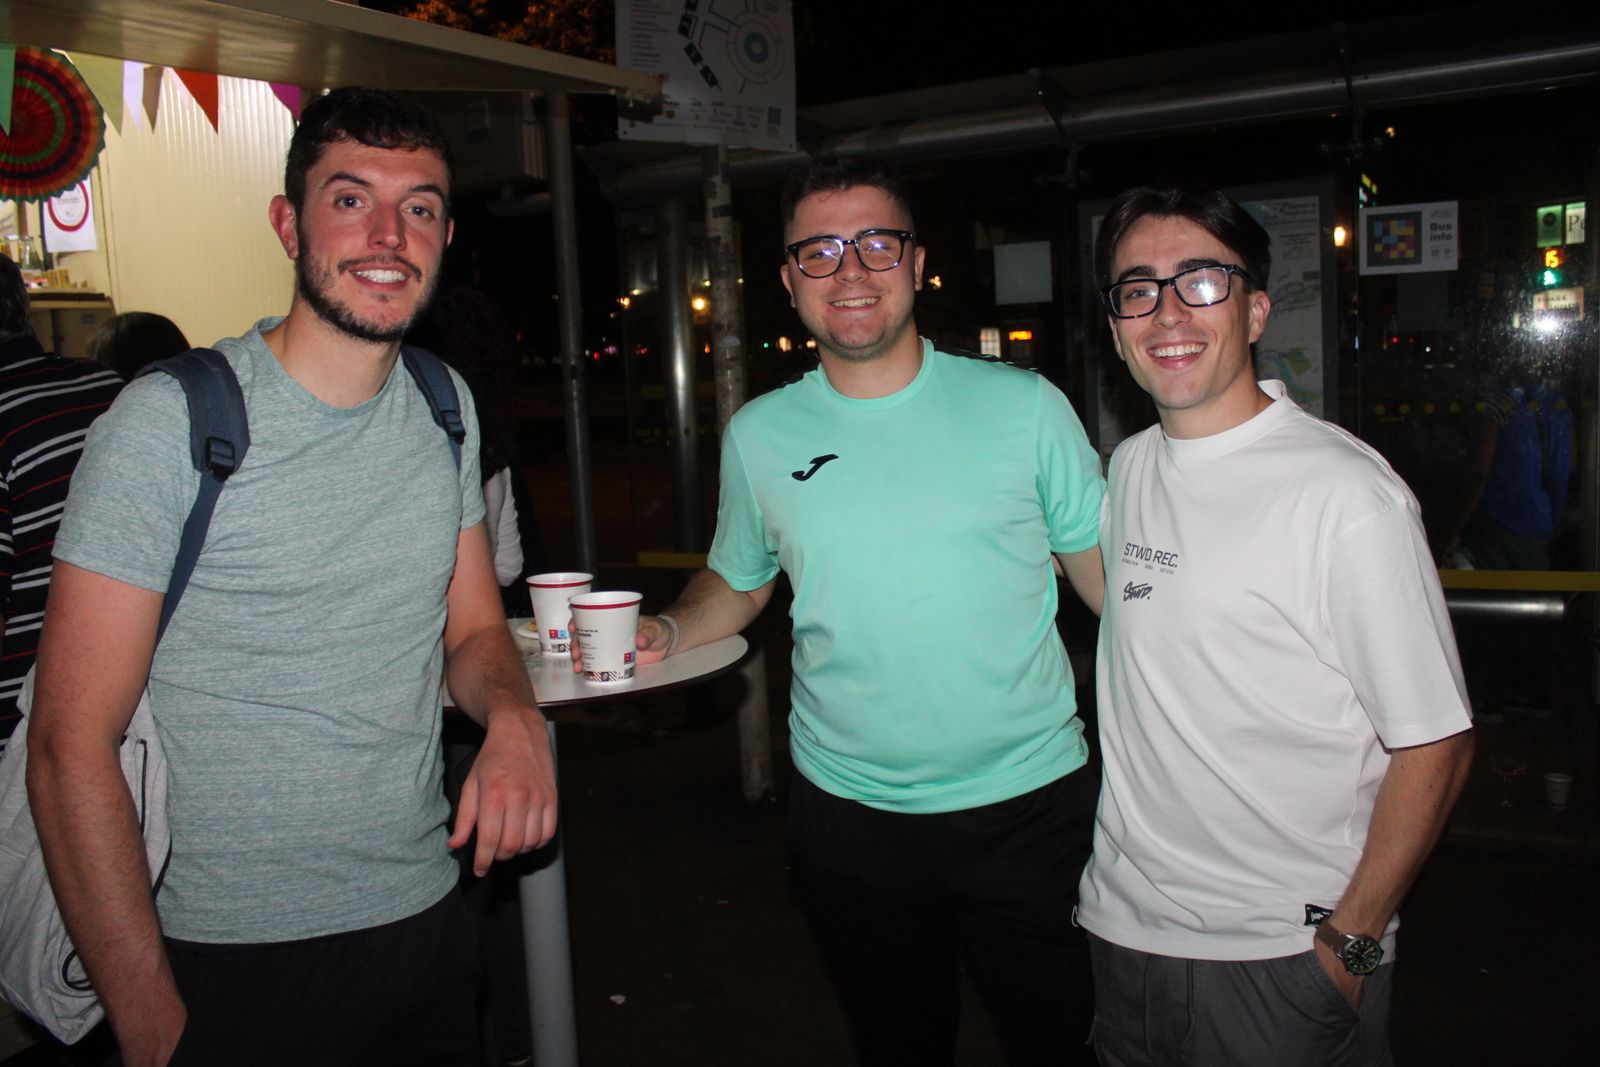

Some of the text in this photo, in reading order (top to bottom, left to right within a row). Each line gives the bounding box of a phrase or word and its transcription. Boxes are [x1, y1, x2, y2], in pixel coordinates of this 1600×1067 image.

[1430, 223, 1452, 231] Bus
[1430, 233, 1452, 242] info
[1124, 542, 1153, 561] STWD
[1152, 550, 1178, 568] REC.
